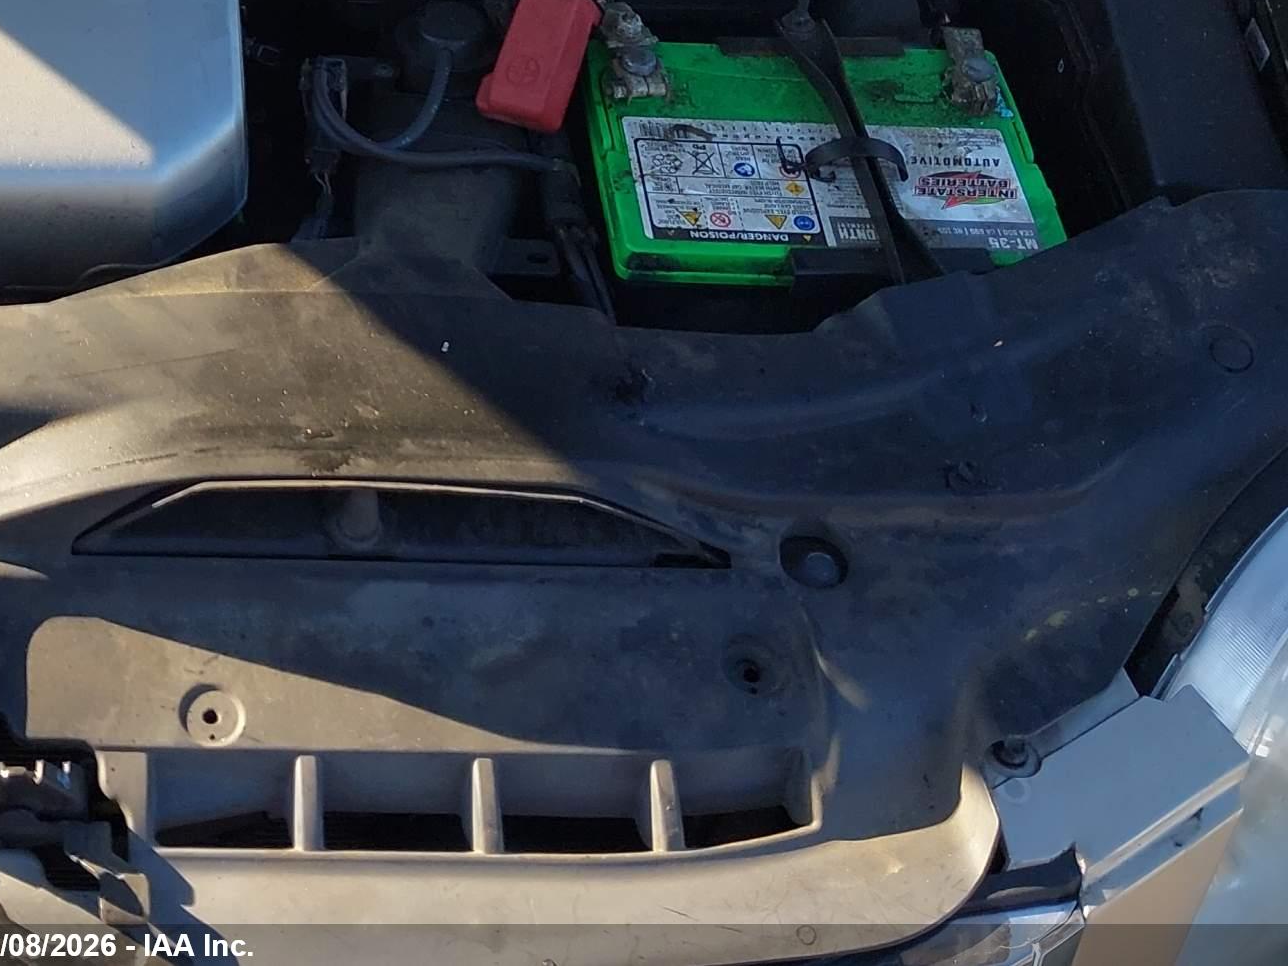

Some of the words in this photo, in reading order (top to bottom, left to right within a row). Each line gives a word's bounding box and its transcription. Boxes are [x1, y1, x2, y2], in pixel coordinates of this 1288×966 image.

[911, 156, 1000, 167] AUTOMOTIVE
[918, 176, 1011, 188] BATTERIES
[914, 185, 1017, 200] INTERSTATE
[690, 230, 789, 242] DANGER/POISON
[988, 236, 1039, 250] MT-35
